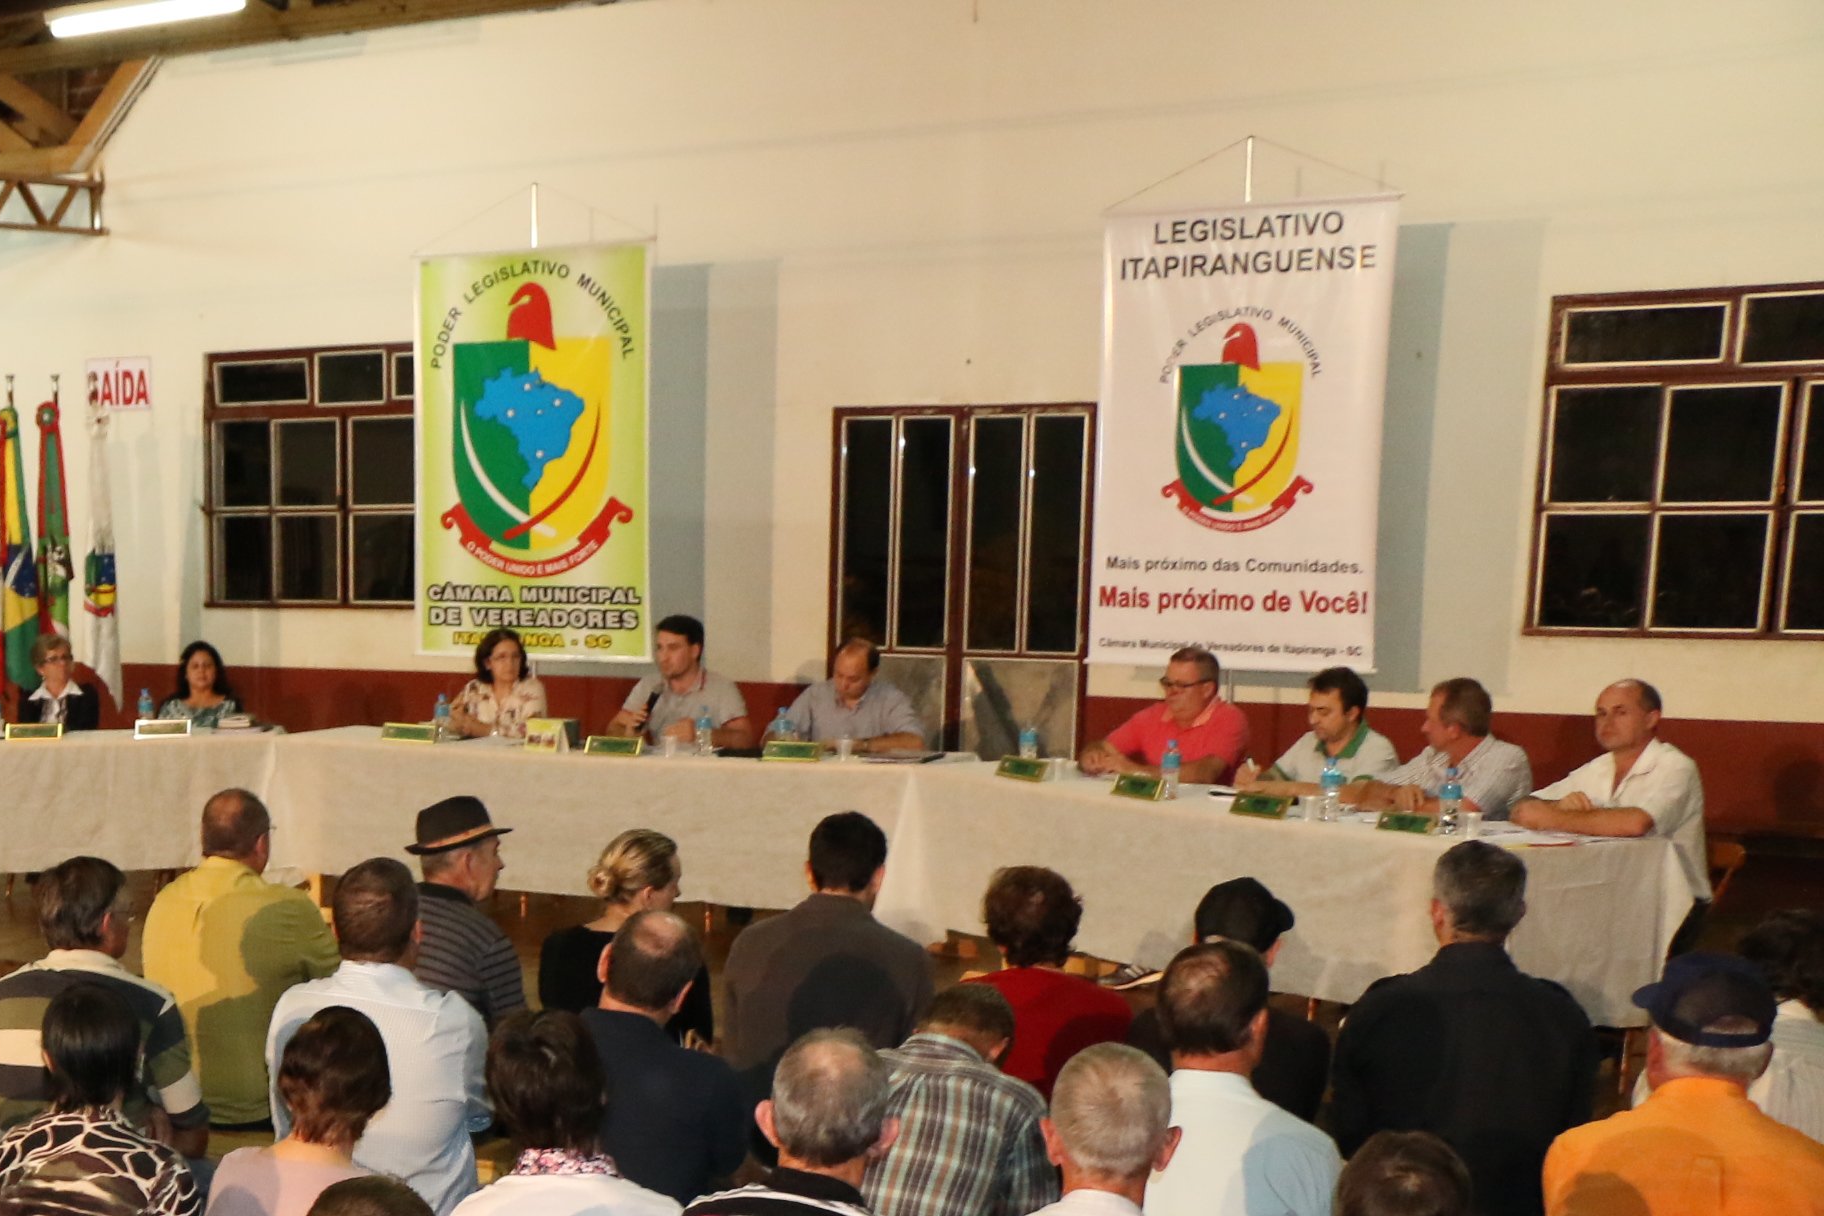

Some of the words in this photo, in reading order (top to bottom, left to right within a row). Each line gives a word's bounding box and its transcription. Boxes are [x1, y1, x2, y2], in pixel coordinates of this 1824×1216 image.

[1154, 211, 1344, 245] LEGISLATIVO
[1121, 245, 1377, 280] ITAPIRANGUENSE
[430, 306, 462, 369] PODER
[463, 260, 570, 304] LEGISLATIVO
[576, 273, 635, 359] MUNICIPAL
[1160, 340, 1186, 383] PODER
[1188, 306, 1272, 337] LEGISLATIVO
[1278, 317, 1323, 378] MUNICIPAL
[1106, 556, 1140, 571] Mais
[1145, 558, 1207, 574] próximo
[1212, 558, 1240, 572] das
[1245, 559, 1363, 574] Comunidades.
[427, 581, 513, 603] CÂMARA
[520, 585, 641, 604] MUNICIPAL
[1099, 586, 1149, 608] Mais
[1158, 588, 1254, 614] próximo
[1263, 591, 1291, 612] de
[1299, 591, 1368, 614] Você!
[429, 606, 461, 626] DE
[470, 607, 640, 630] VEREADORES
[453, 631, 565, 647] ITANGA
[585, 634, 612, 648] SC
